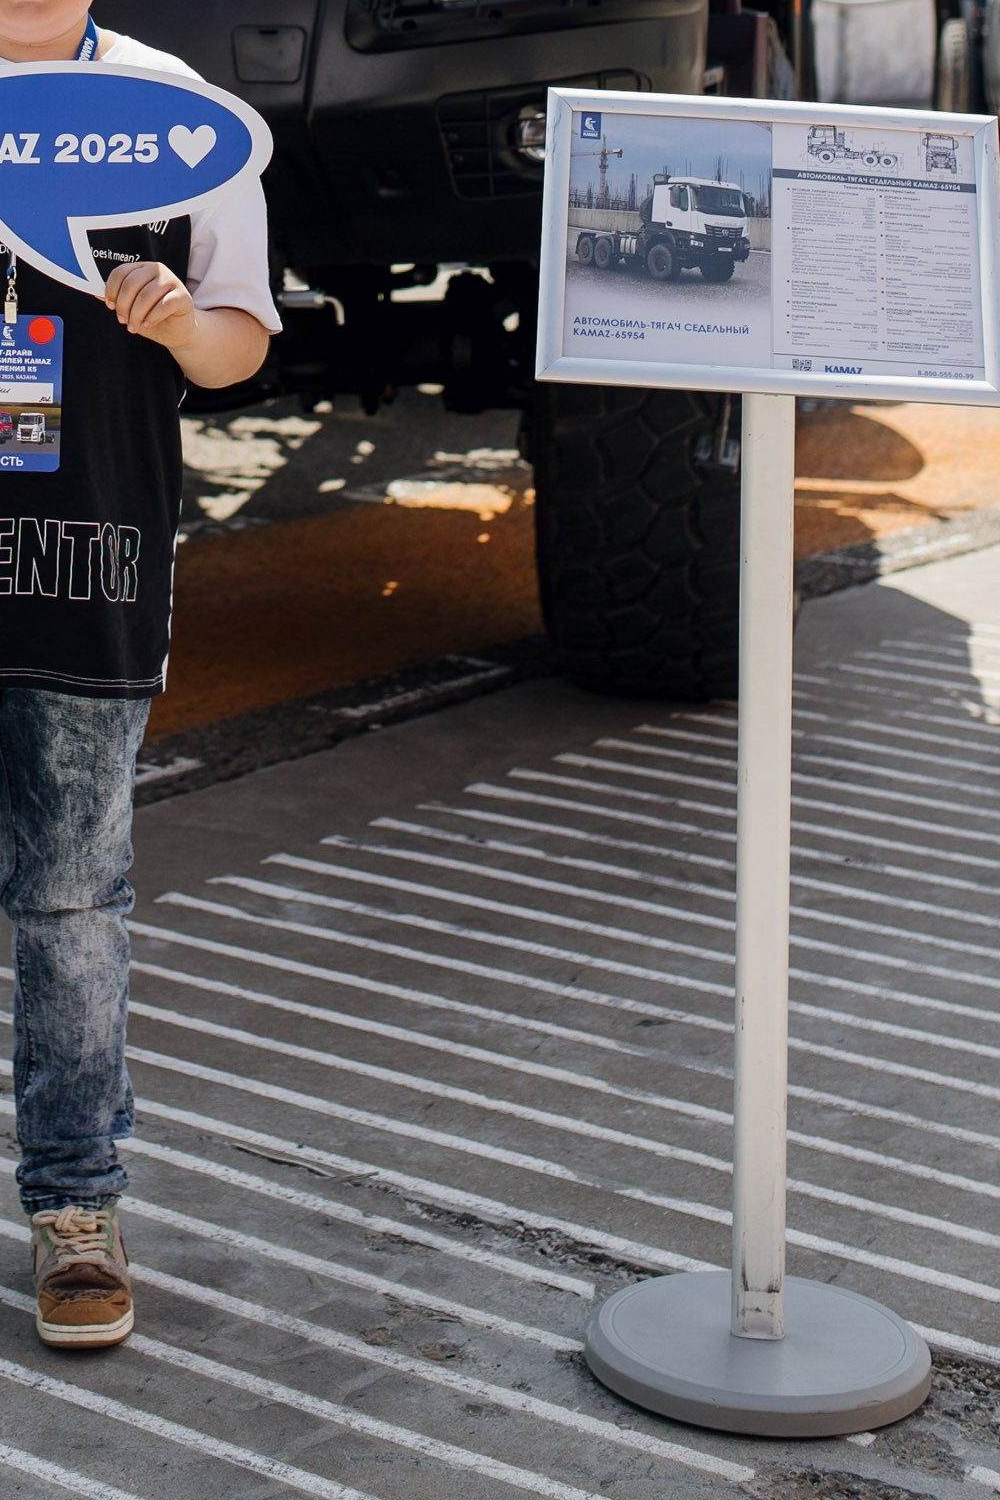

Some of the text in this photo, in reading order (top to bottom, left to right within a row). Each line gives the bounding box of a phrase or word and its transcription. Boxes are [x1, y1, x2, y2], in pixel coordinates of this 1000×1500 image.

[54, 133, 159, 164] 2025
[796, 171, 868, 184] АВТОМОБИЛЬ-ТЯГАЧ
[868, 177, 912, 188] СЕДЕЛЬНЫЙ
[573, 316, 749, 335] АВТОМОБИЛЬ-ТЯГАЧ СЕДЕЛЬНЫЙ
[573, 327, 645, 340] KAMAZ-65954
